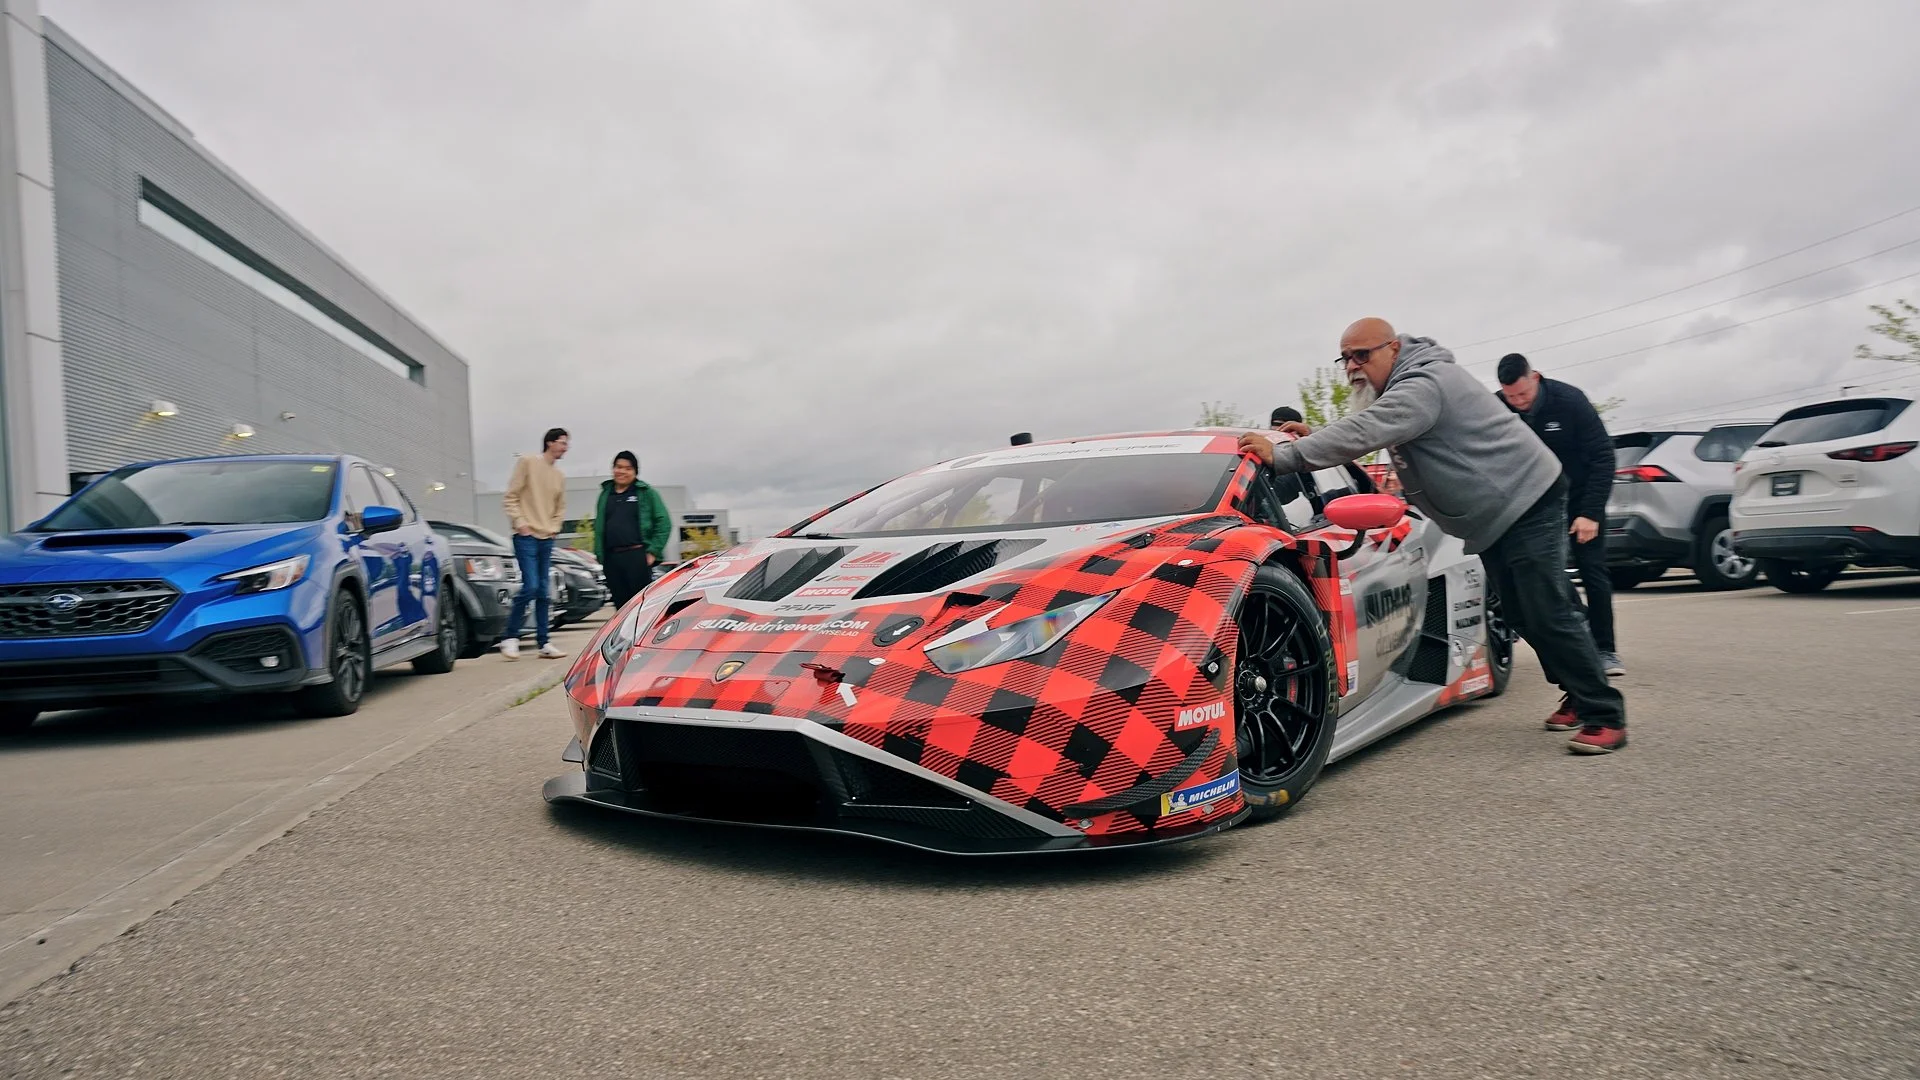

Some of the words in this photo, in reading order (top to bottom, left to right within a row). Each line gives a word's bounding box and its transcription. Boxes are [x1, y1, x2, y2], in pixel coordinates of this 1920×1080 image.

[800, 588, 851, 596] MOTUL
[1178, 701, 1226, 727] MOTUL
[1188, 778, 1236, 803] MICHELIN
